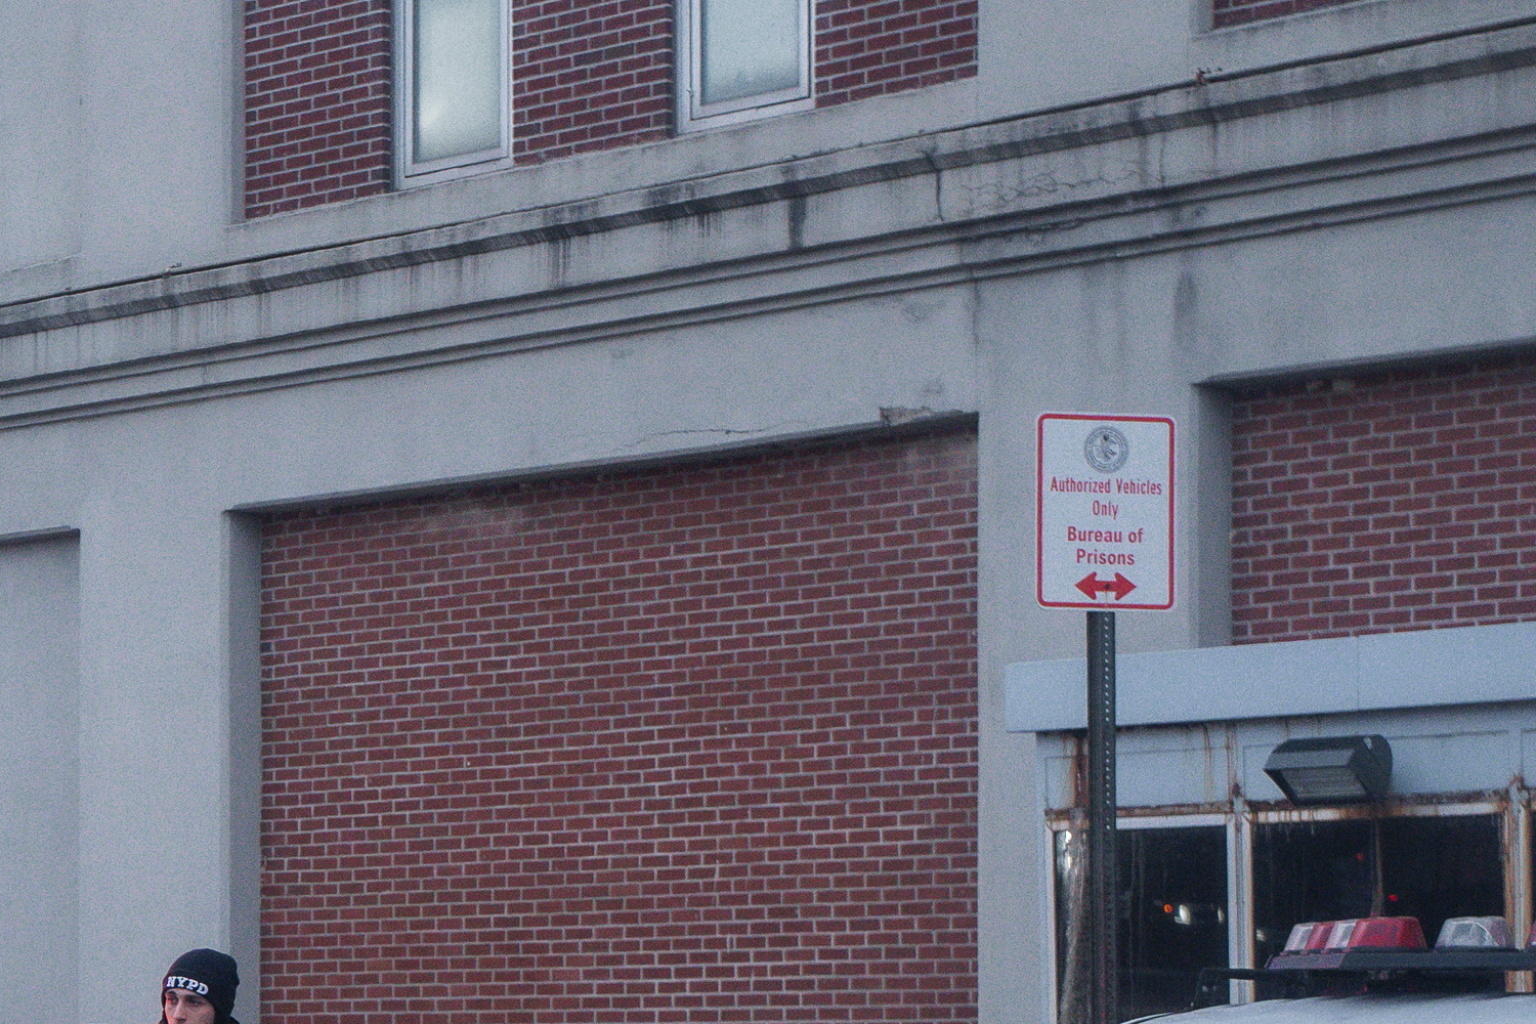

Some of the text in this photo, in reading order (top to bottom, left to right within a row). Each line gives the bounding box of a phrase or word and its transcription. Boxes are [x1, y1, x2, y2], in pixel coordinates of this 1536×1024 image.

[1050, 476, 1162, 495] Authorized Vehicles
[1092, 500, 1119, 520] Only
[1067, 526, 1144, 543] Bureau of
[1076, 549, 1135, 565] Prisons
[166, 975, 209, 996] NYPD
